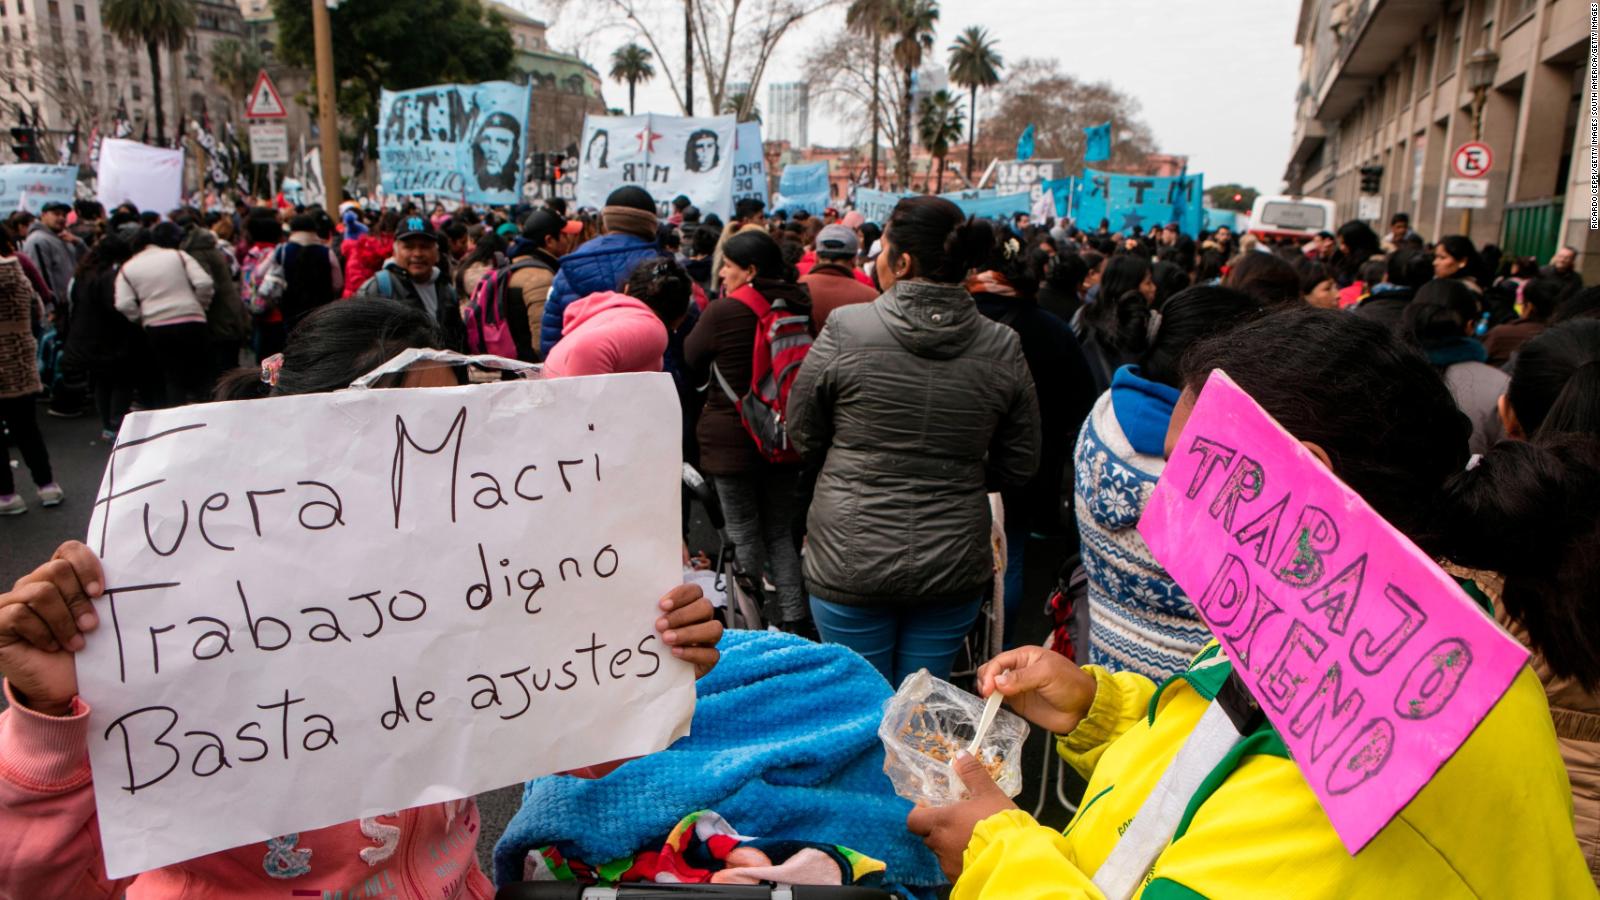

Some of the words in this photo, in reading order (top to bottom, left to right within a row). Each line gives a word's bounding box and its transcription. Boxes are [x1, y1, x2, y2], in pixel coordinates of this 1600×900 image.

[93, 422, 347, 558] Fuera
[391, 405, 602, 529] Macri
[103, 579, 427, 684] Trabajo
[466, 543, 620, 615] digno
[1185, 435, 1473, 721] TRABAJO
[103, 689, 339, 796] Basta
[381, 675, 437, 730] de
[470, 631, 662, 720] ajustes
[1200, 553, 1396, 796] DIGNO
